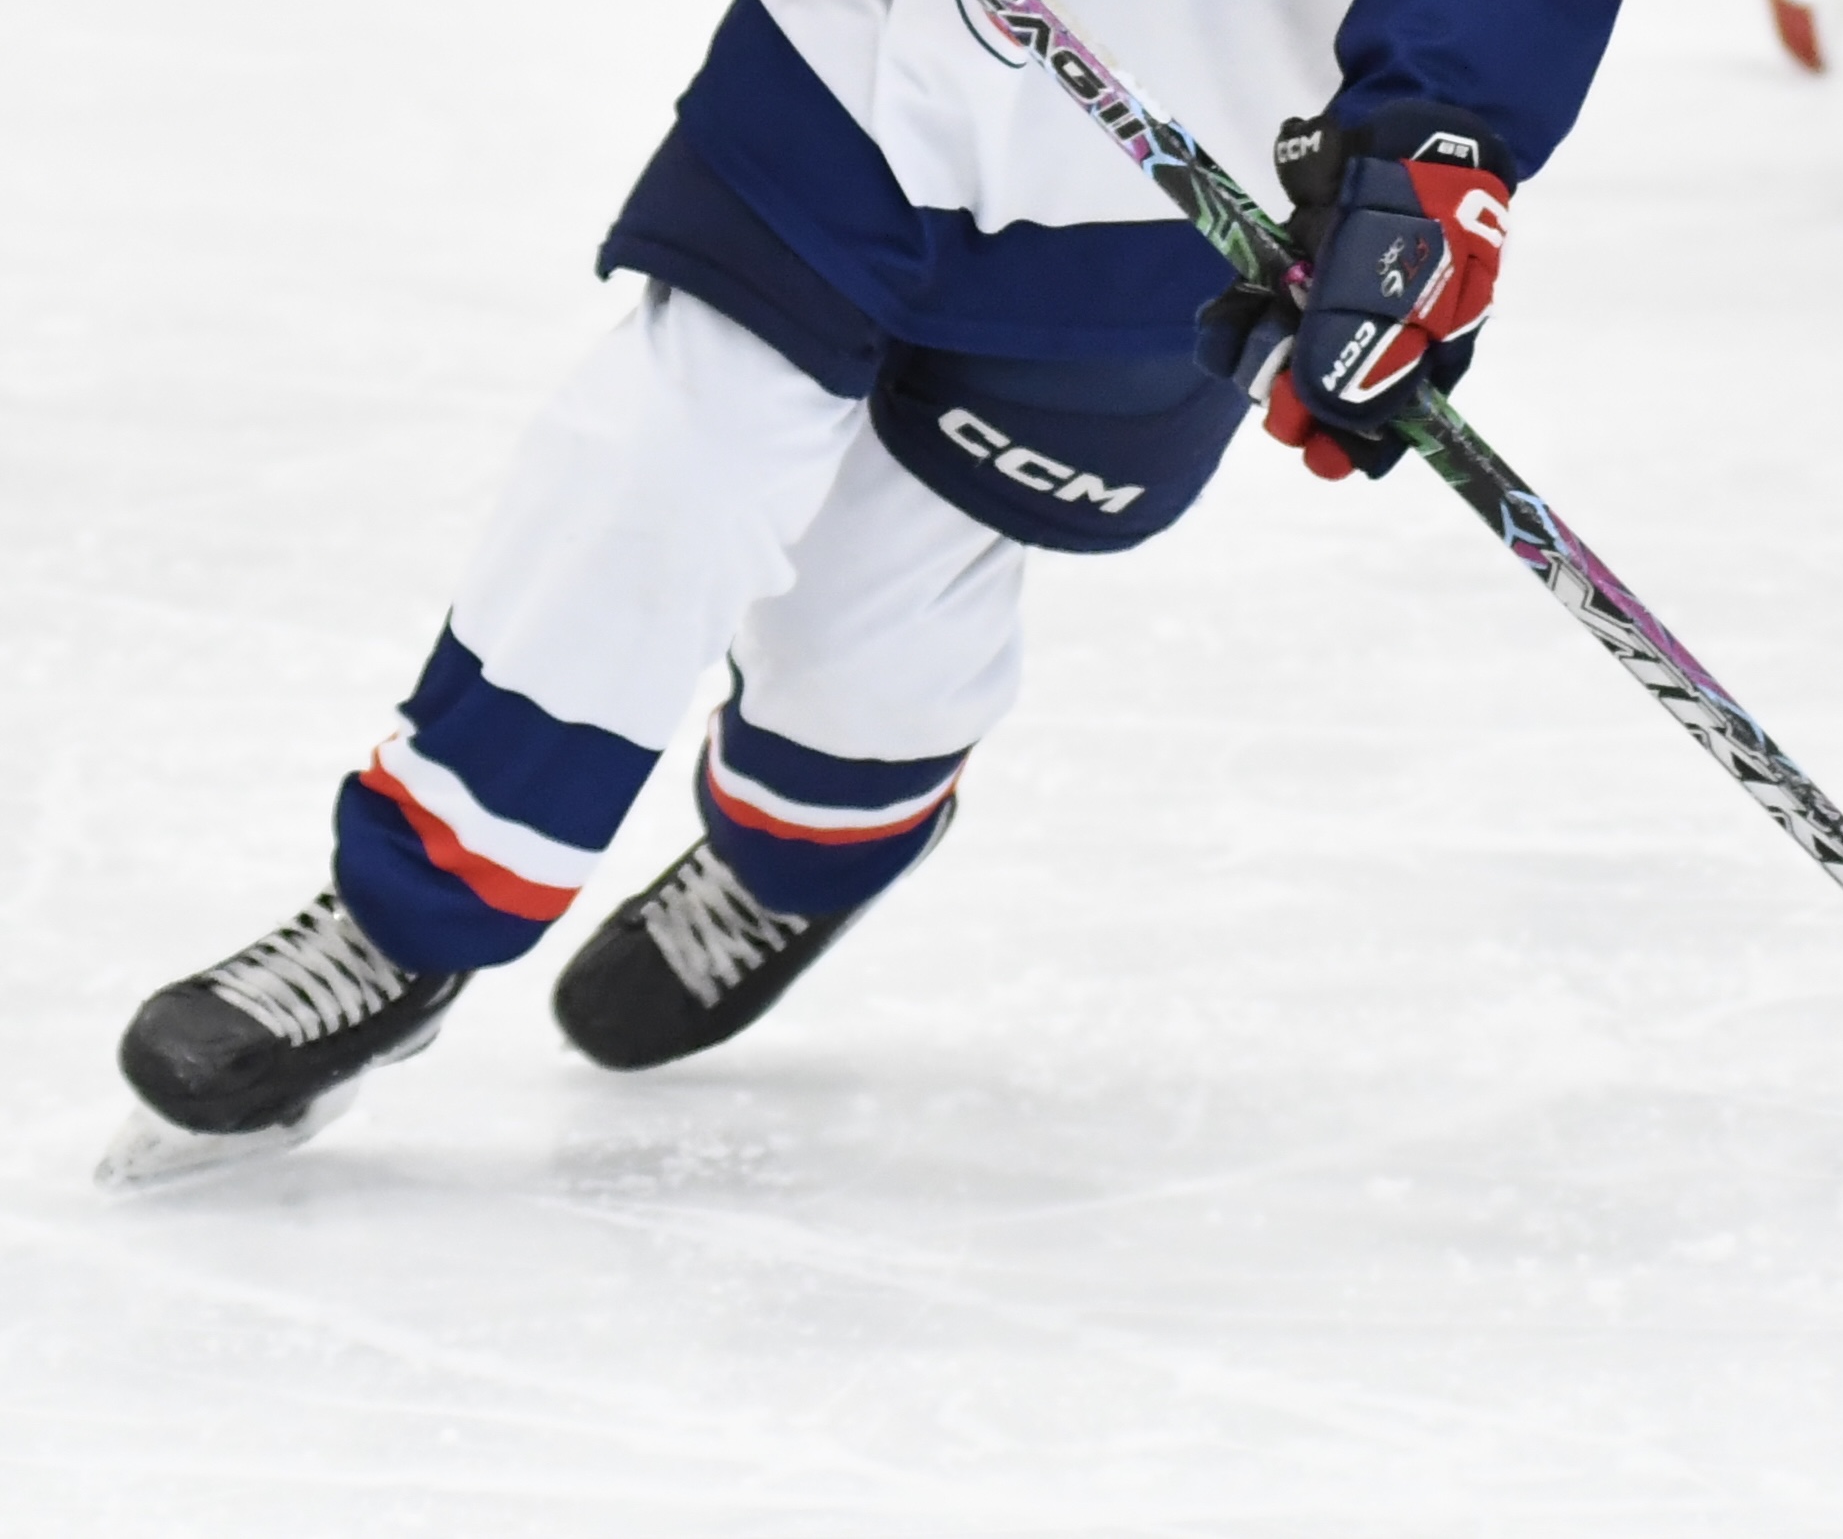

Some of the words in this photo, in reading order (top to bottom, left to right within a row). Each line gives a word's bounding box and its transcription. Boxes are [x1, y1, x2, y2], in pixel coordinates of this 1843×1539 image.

[1277, 130, 1321, 163] CCM
[1322, 320, 1376, 391] CCM
[938, 408, 1145, 514] CCM
